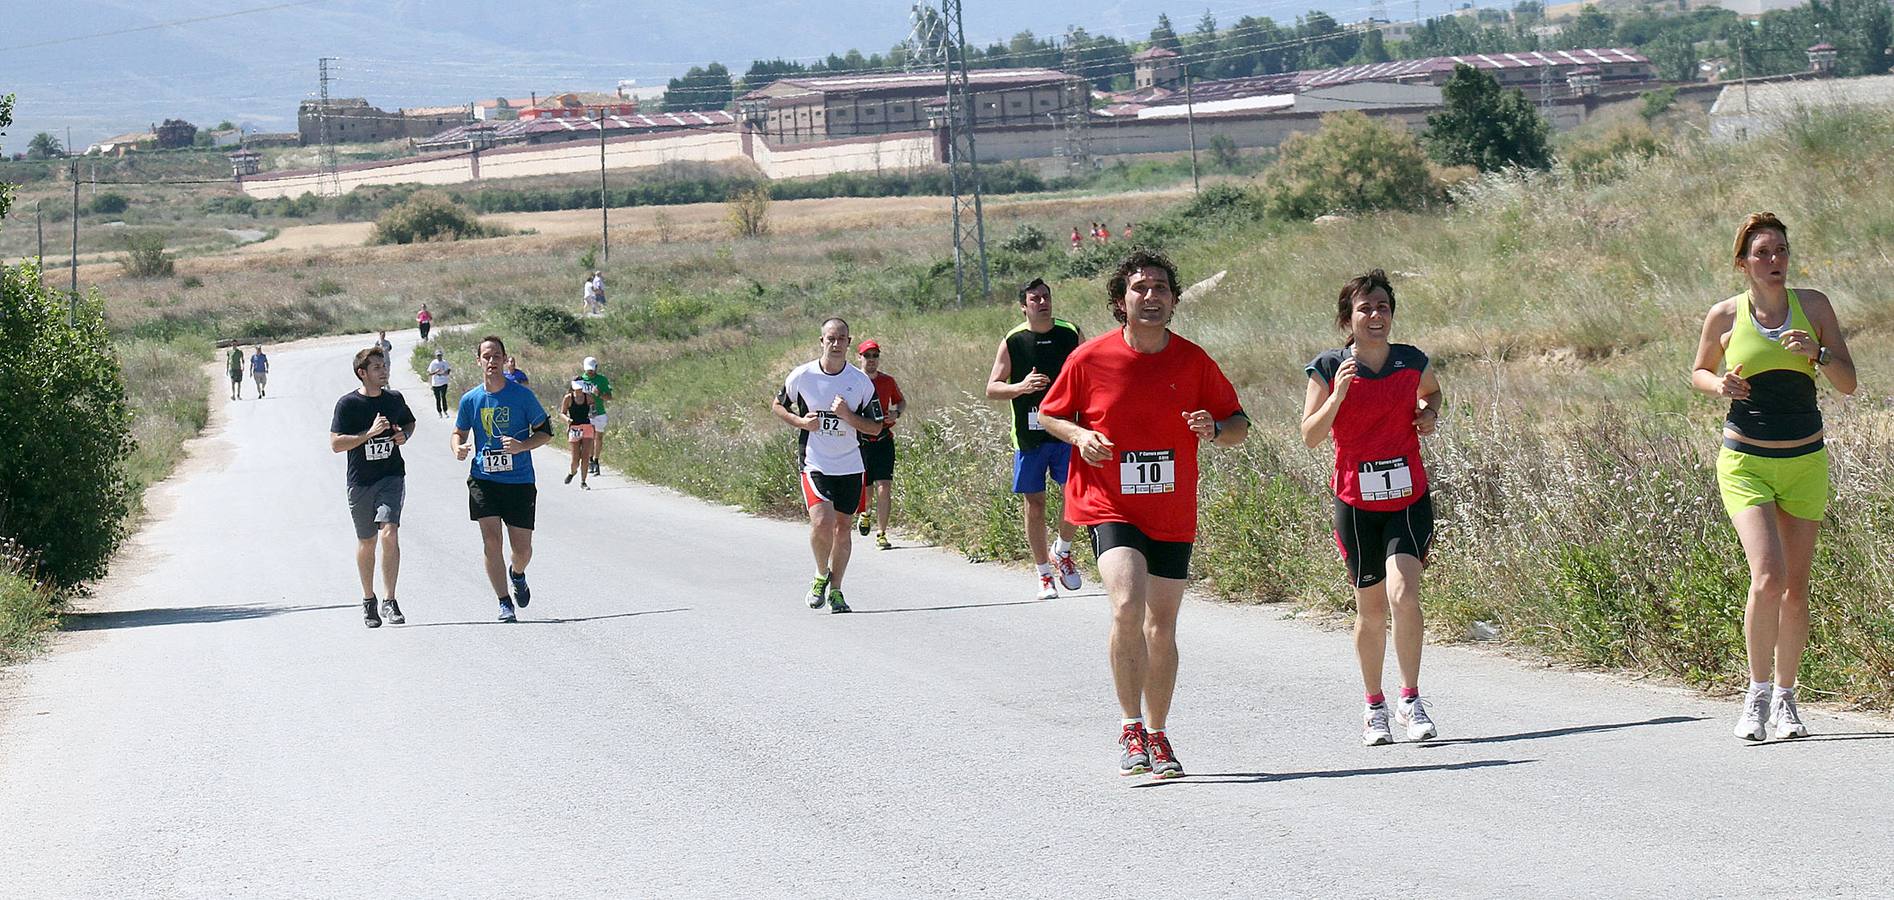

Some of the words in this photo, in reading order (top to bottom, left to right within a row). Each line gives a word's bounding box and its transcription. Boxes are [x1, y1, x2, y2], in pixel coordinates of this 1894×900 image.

[823, 419, 839, 430] 62
[370, 443, 390, 454] 124
[486, 455, 508, 467] 126
[1136, 463, 1161, 483] 10
[1381, 471, 1392, 490] 1
